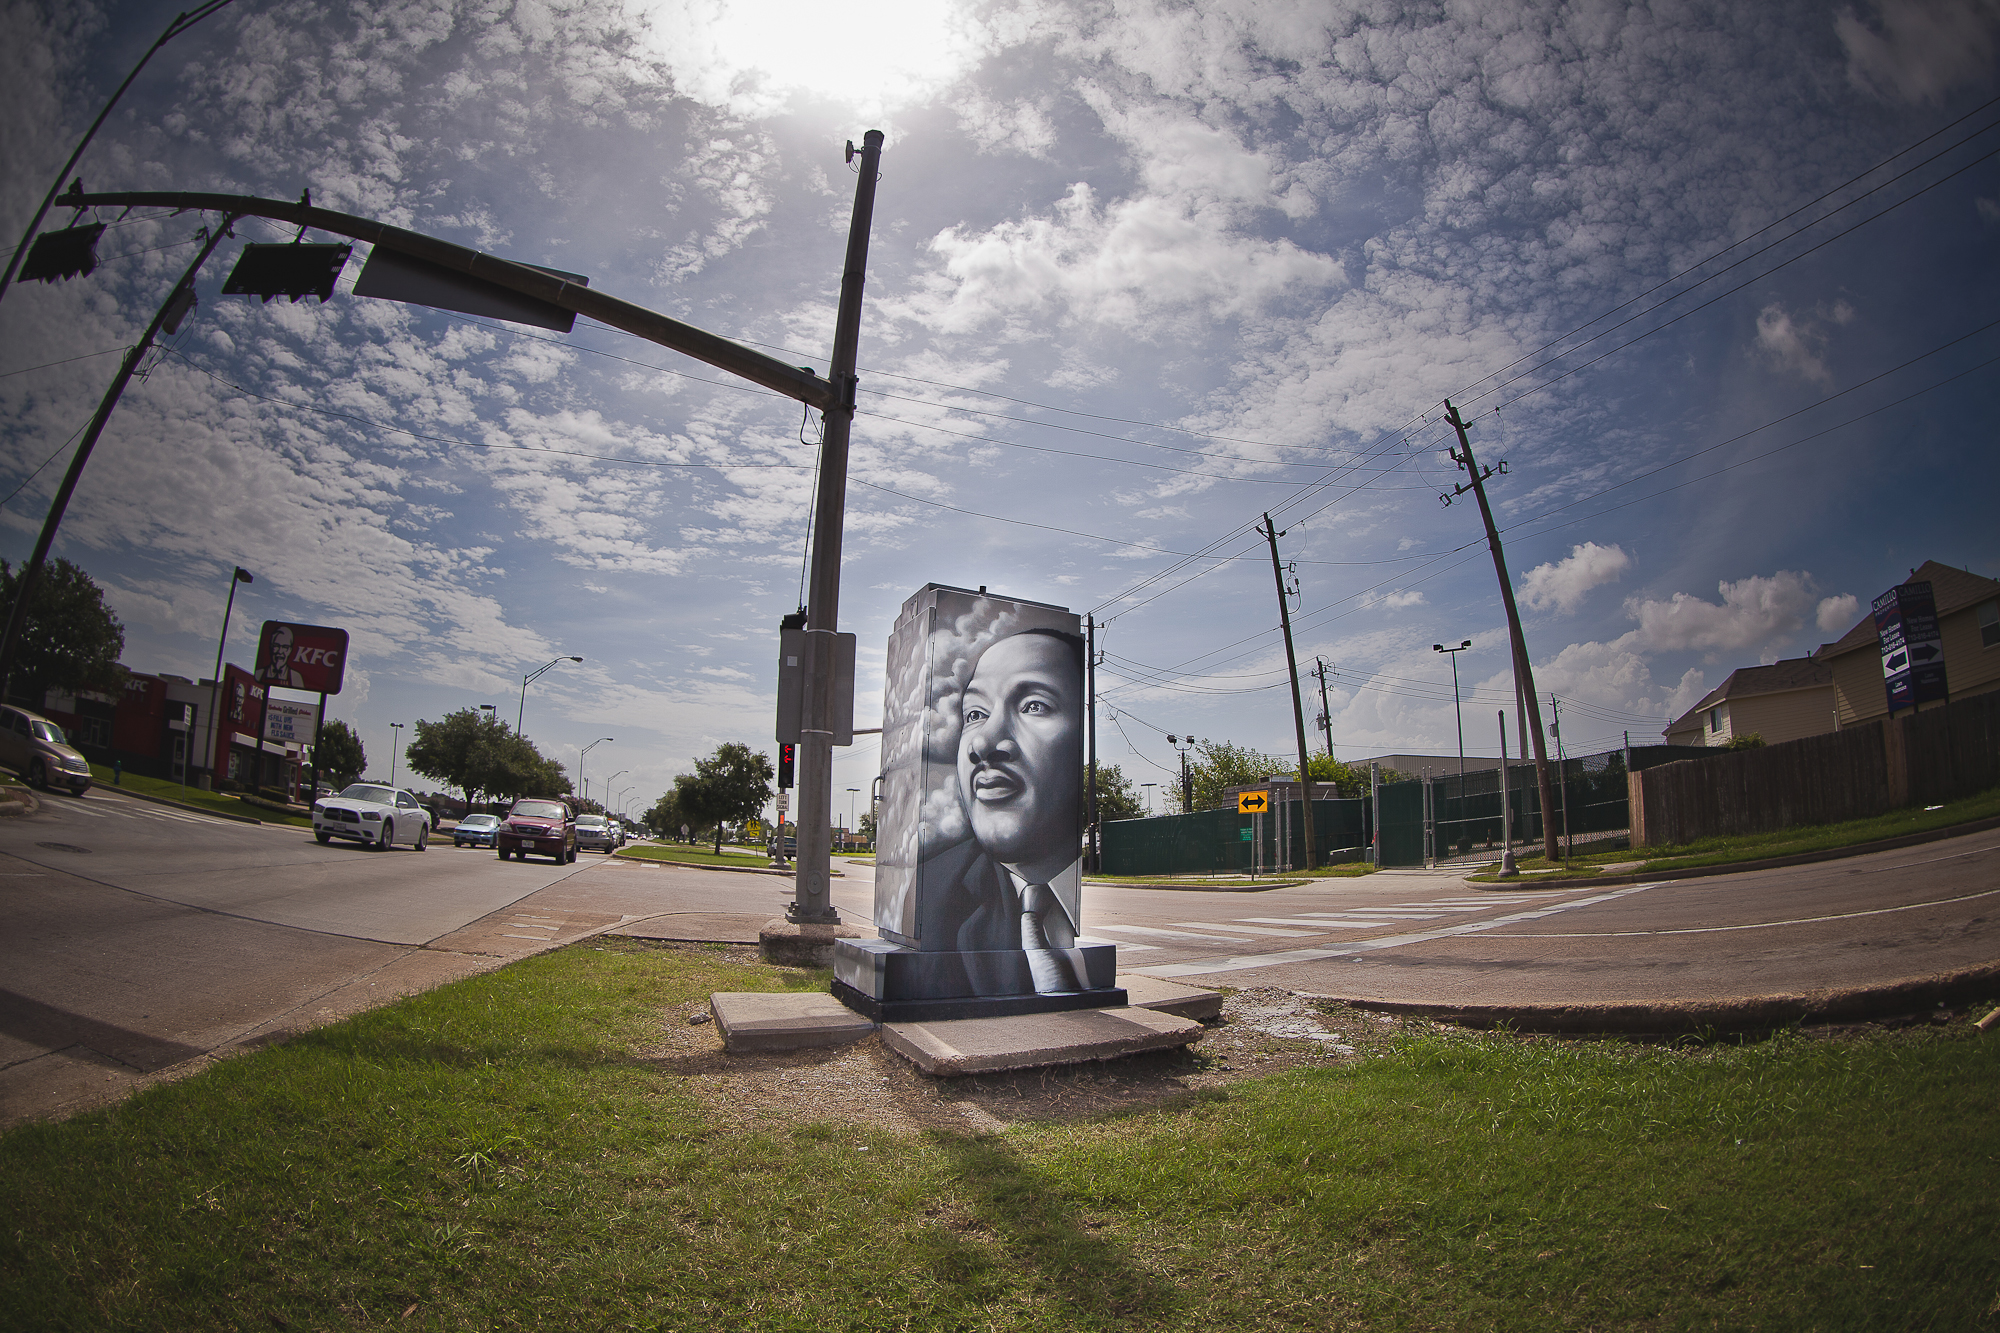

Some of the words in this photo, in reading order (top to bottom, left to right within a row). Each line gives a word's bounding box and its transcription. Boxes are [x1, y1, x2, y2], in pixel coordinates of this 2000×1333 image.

[1898, 583, 1931, 597] CAMILLO
[1872, 589, 1897, 611] CAMILLO
[1901, 594, 1932, 602] PROPERTIES
[1906, 617, 1918, 625] New
[1917, 615, 1935, 623] Homes
[1879, 629, 1888, 638] New
[1887, 622, 1901, 633] Homes
[1910, 624, 1919, 632] For
[1919, 623, 1933, 631] Lease
[1889, 631, 1900, 641] Lease
[293, 646, 338, 668] KFC
[124, 679, 149, 692] KFC
[270, 722, 282, 730] WITH
[283, 724, 293, 732] NEW
[280, 731, 295, 739] SAUCE
